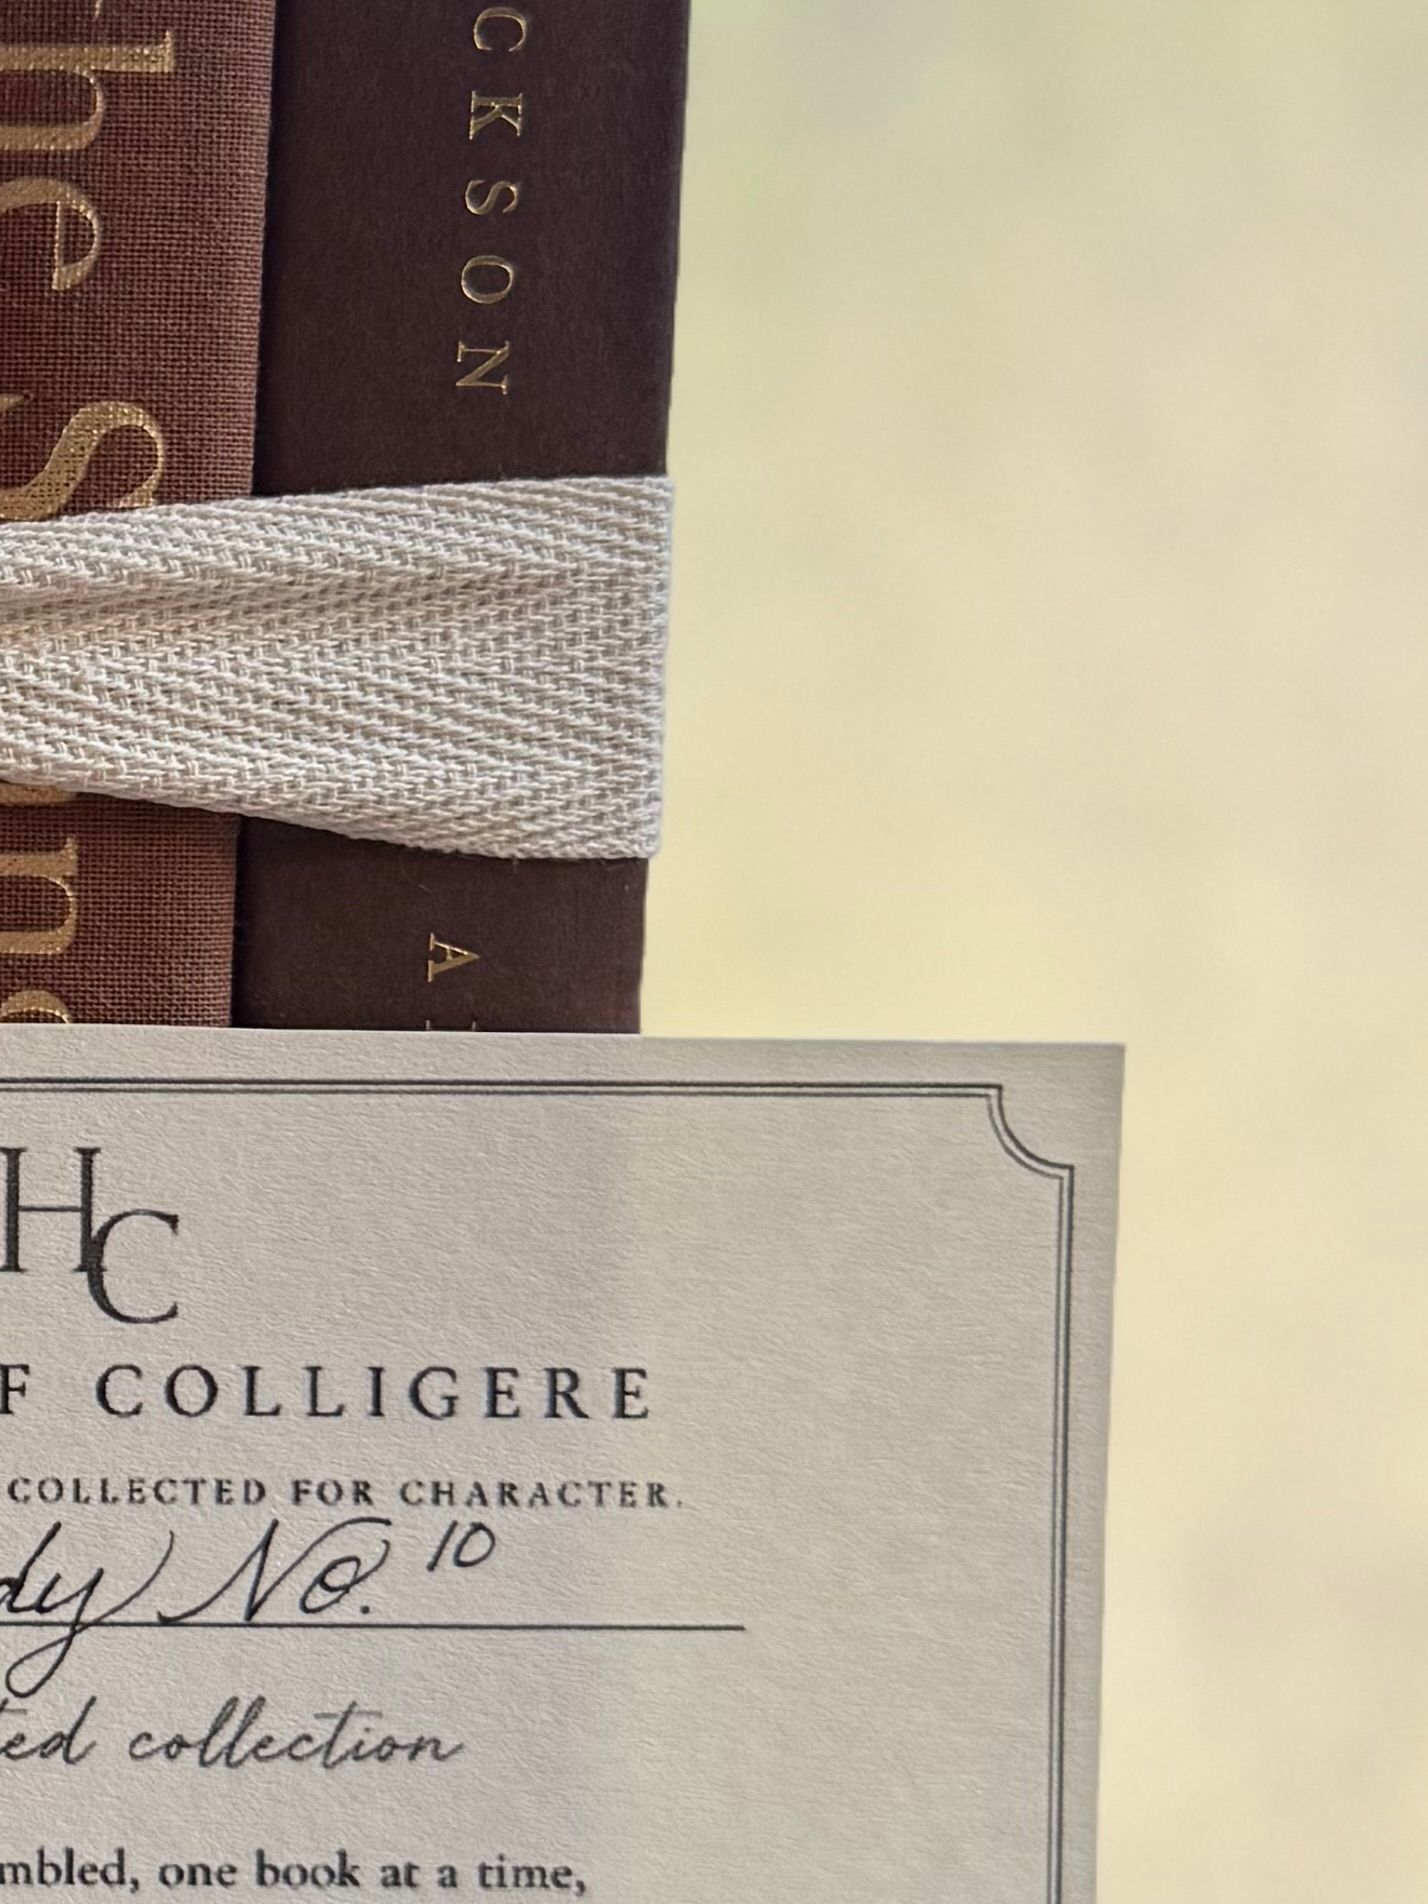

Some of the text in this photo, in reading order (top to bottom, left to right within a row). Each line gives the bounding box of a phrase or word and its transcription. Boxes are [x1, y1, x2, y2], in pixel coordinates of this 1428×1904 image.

[96, 1364, 648, 1420] COLLIGERE
[7, 1478, 266, 1505] COLLECTED
[292, 1479, 373, 1506] FOR
[398, 1479, 683, 1509] CHARACTER.
[425, 1519, 496, 1572] 10
[128, 1695, 464, 1770] collection
[159, 1863, 237, 1888] one
[256, 1849, 360, 1889] book
[381, 1862, 420, 1889] at
[437, 1865, 458, 1889] a
[478, 1854, 586, 1897] time,
